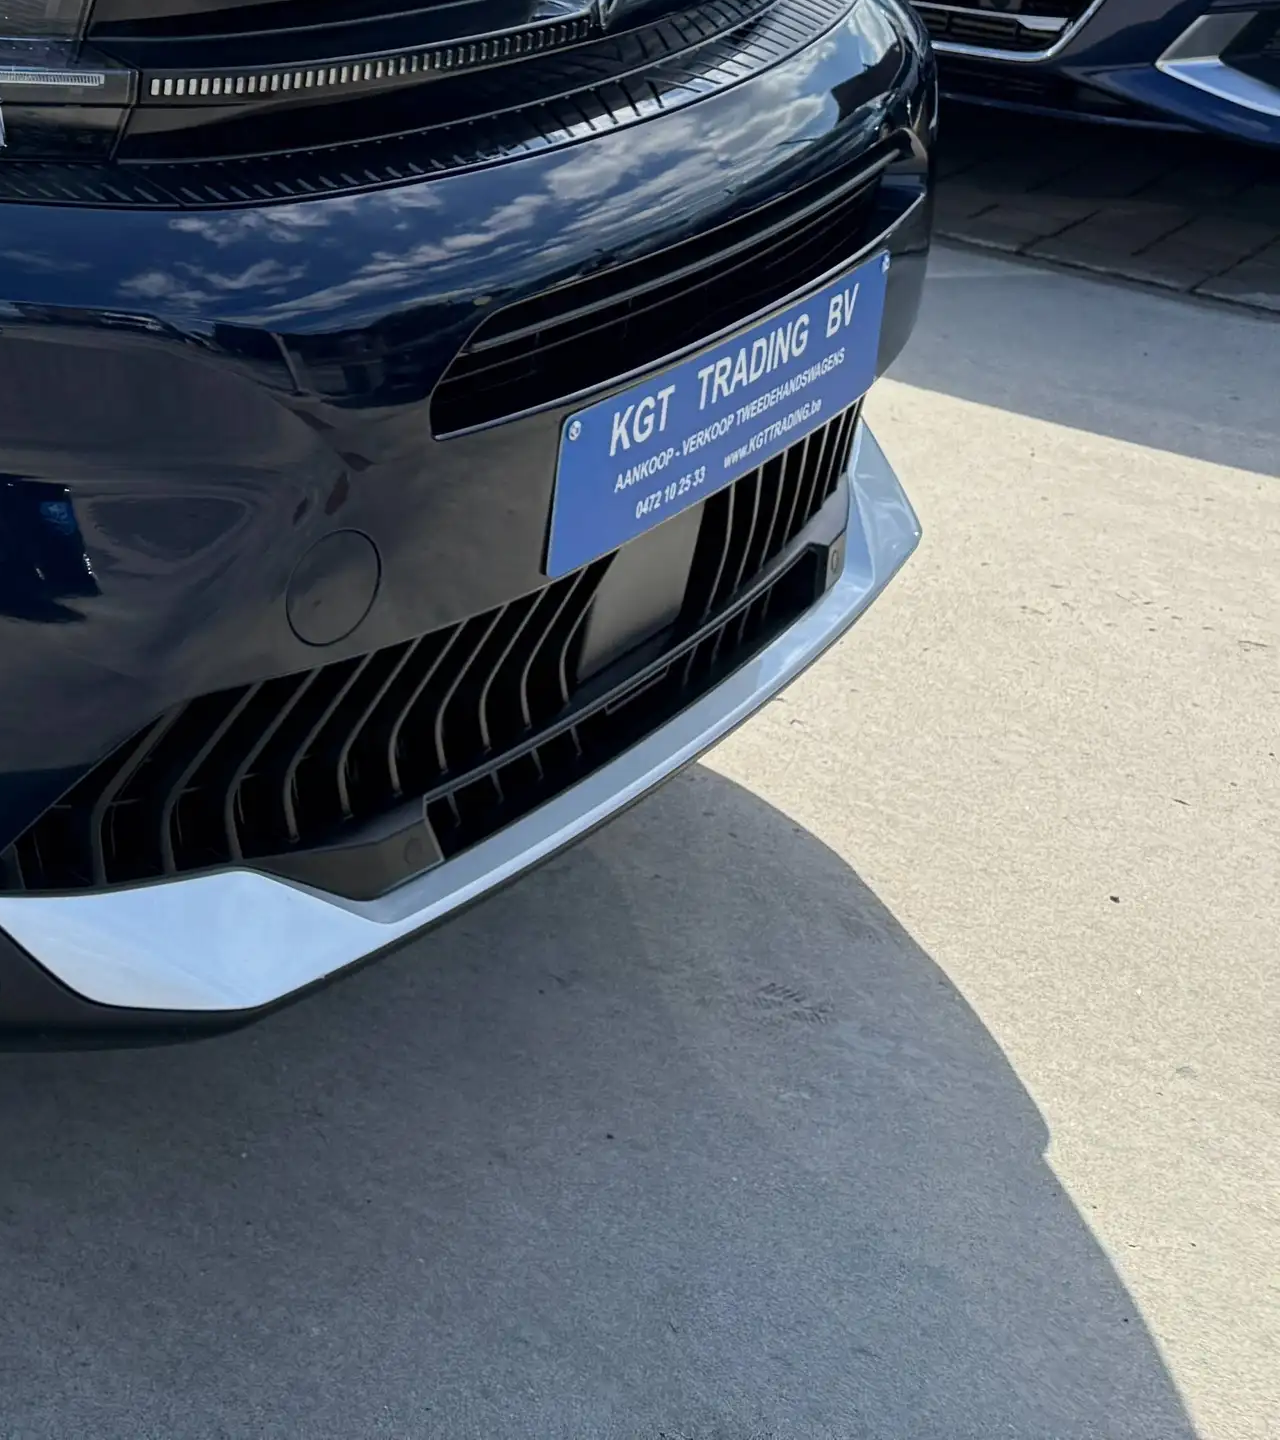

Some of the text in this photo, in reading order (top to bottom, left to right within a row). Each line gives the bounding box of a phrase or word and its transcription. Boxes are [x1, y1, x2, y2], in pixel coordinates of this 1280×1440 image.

[609, 283, 860, 457] KGT TRADING BV
[614, 447, 674, 493] AANKOOP
[682, 413, 735, 456] VERKOOP
[736, 347, 846, 426] TWEEDEHANDSWAGENS
[635, 399, 823, 519] 0472 10 25 33 www.KGTTRADING.be
